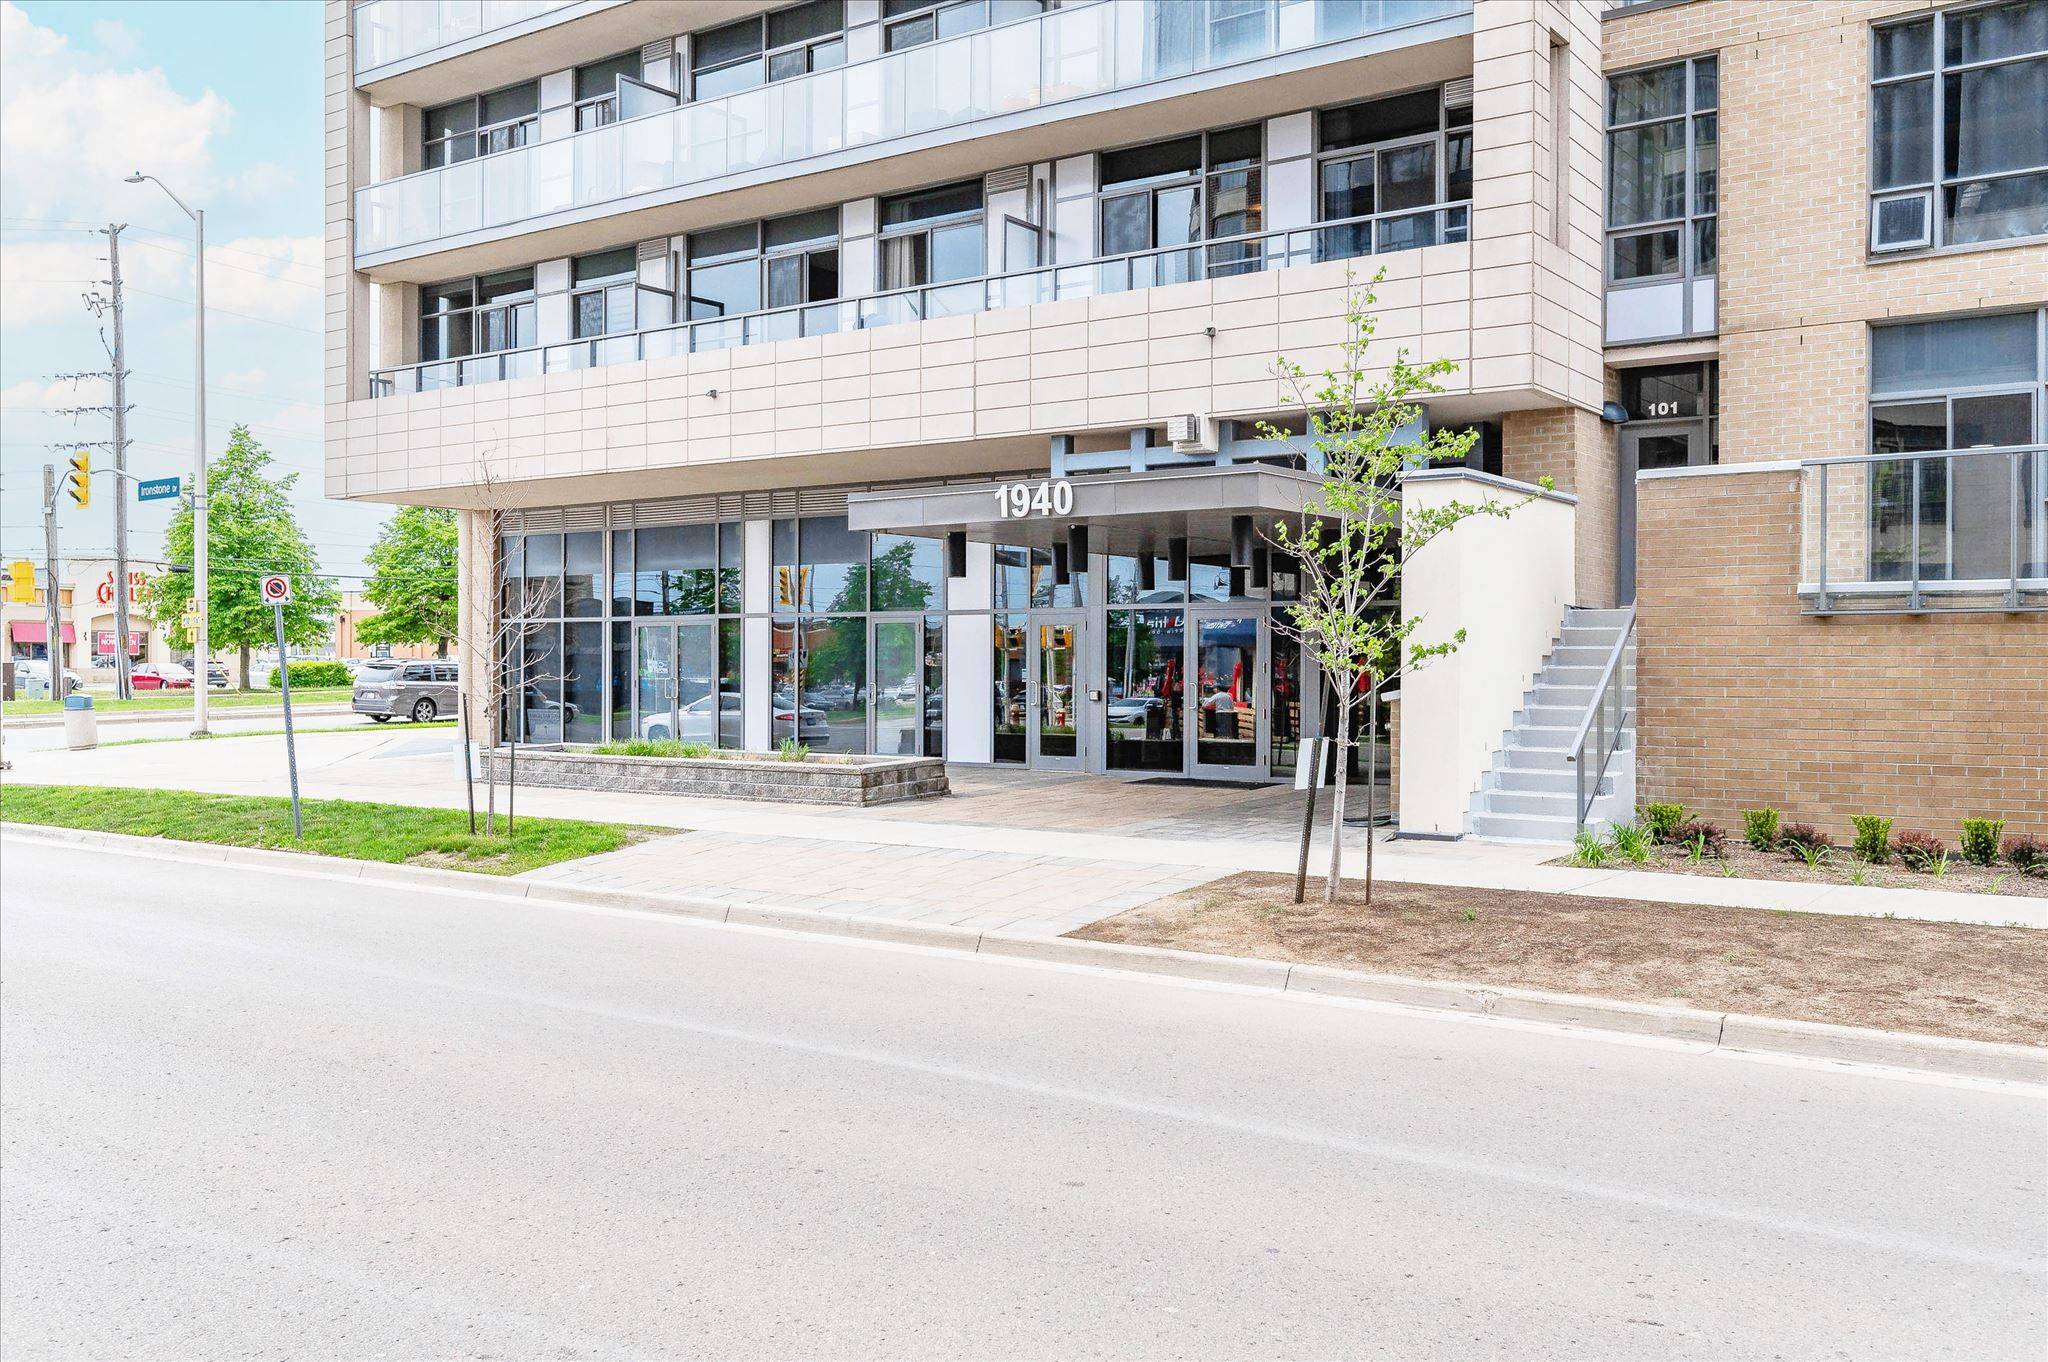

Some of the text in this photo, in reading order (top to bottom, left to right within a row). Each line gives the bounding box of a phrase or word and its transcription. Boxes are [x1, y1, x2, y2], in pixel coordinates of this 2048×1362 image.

[1648, 401, 1678, 416] 101
[141, 484, 171, 496] Ironstone
[994, 480, 1073, 518] 1940
[107, 571, 147, 585] SISS
